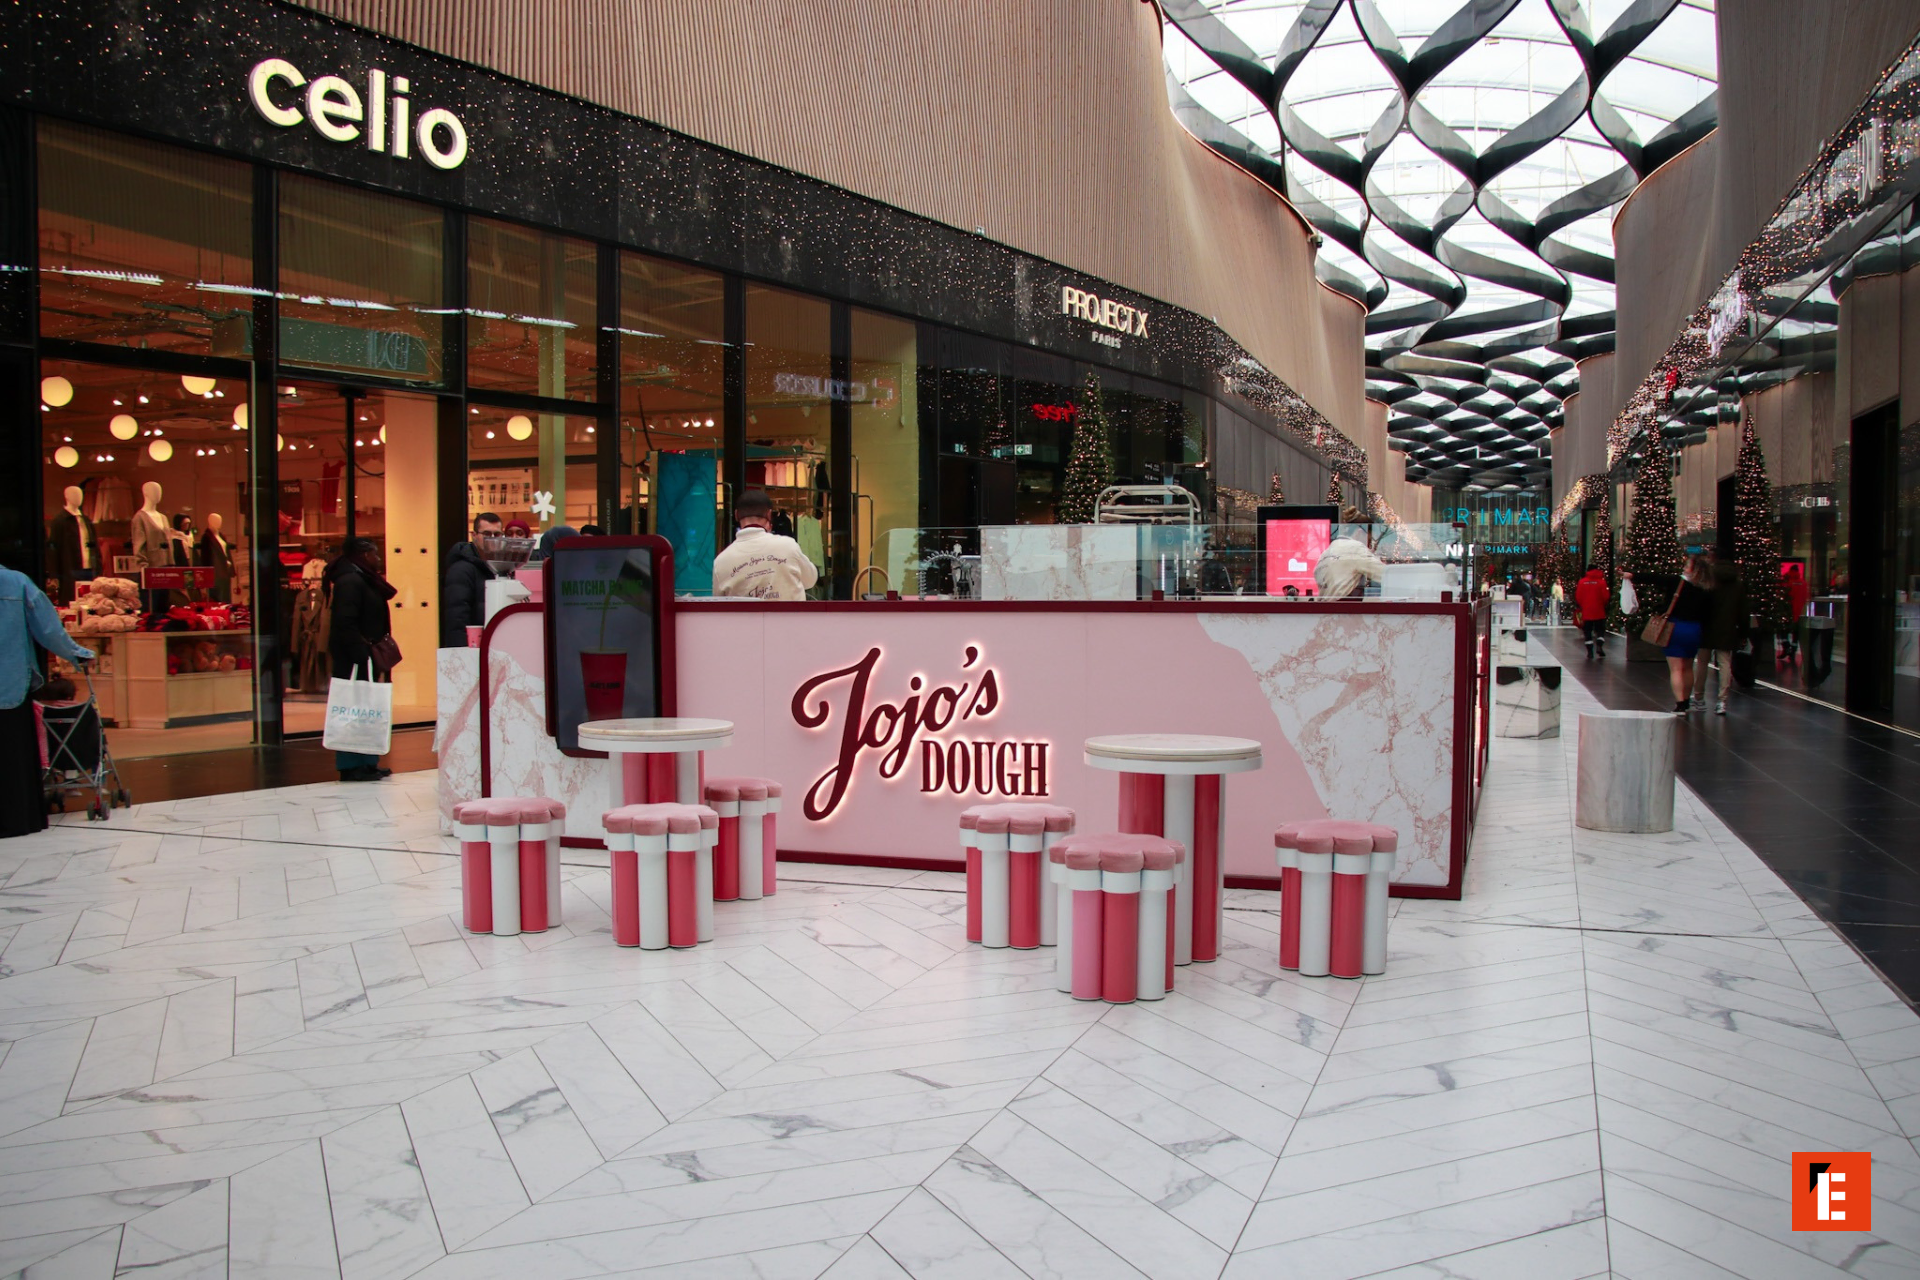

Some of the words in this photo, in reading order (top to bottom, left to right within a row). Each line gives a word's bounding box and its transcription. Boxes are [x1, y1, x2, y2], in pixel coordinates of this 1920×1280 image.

[249, 58, 468, 169] celio
[1091, 330, 1121, 349] PARIS
[1442, 507, 1549, 526] PRIMAR
[561, 580, 606, 595] MATCHA
[331, 705, 383, 719] PRIMARK
[791, 646, 999, 821] Jojo's
[920, 740, 1049, 797] DOUGH
